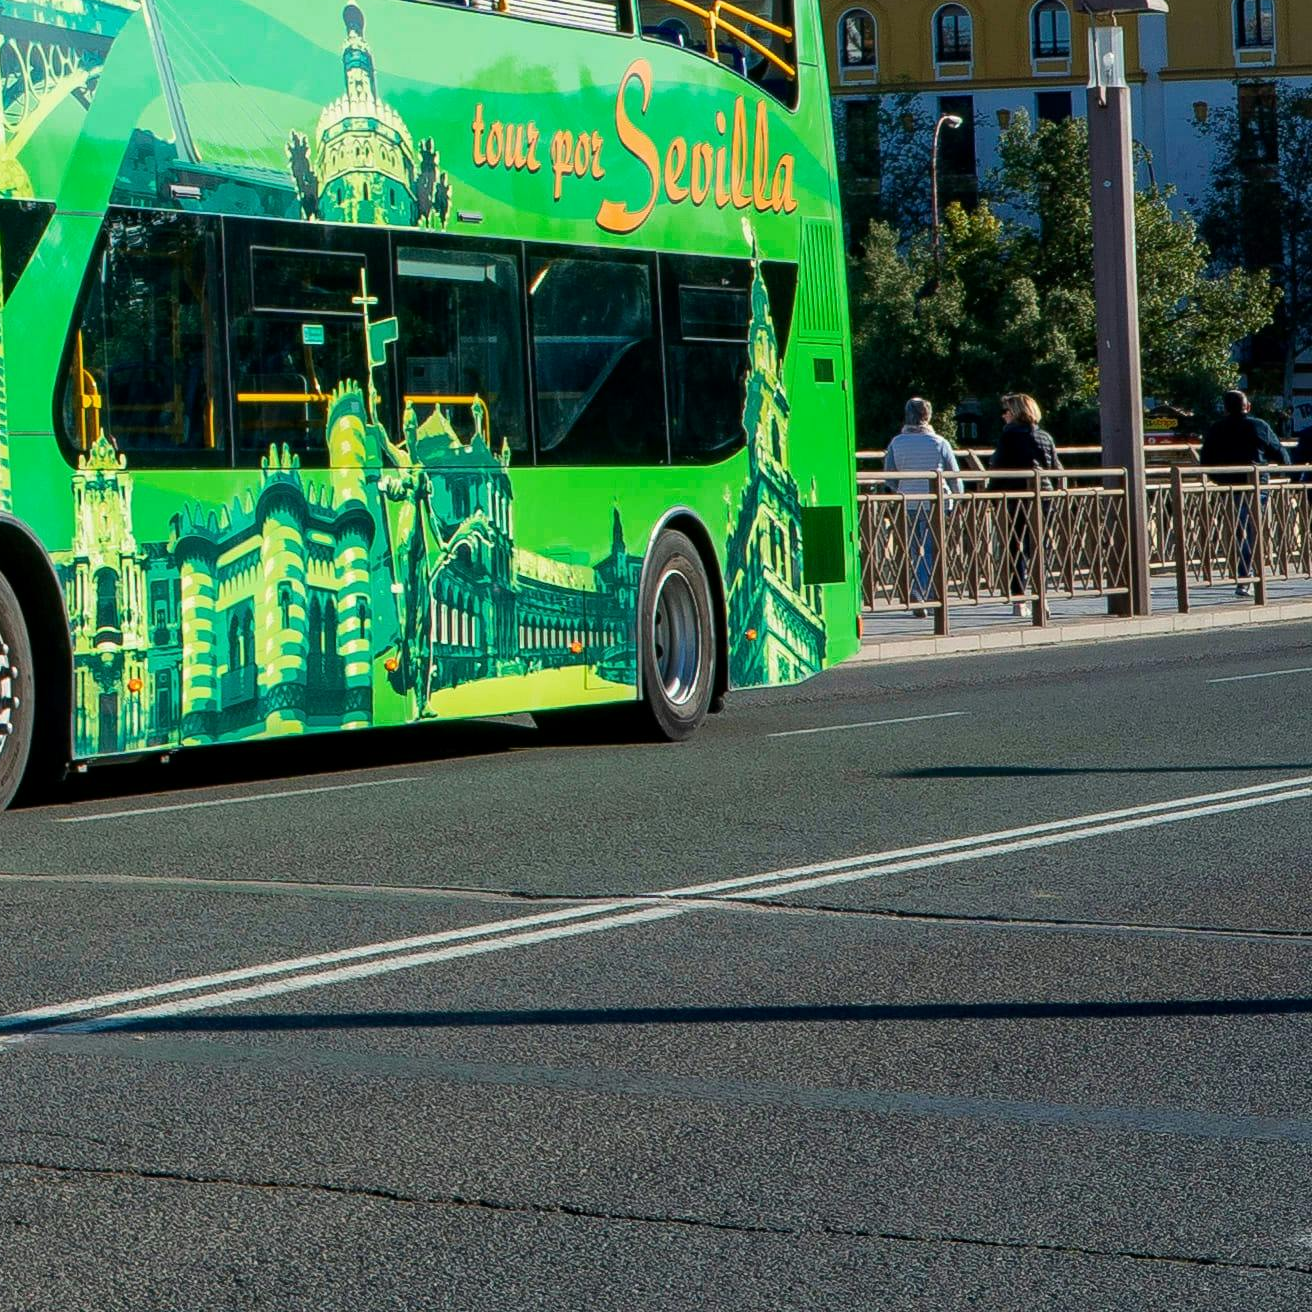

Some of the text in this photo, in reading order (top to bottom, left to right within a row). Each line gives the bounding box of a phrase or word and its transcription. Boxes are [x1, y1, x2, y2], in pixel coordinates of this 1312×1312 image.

[472, 58, 797, 233] tour por Sevilla
